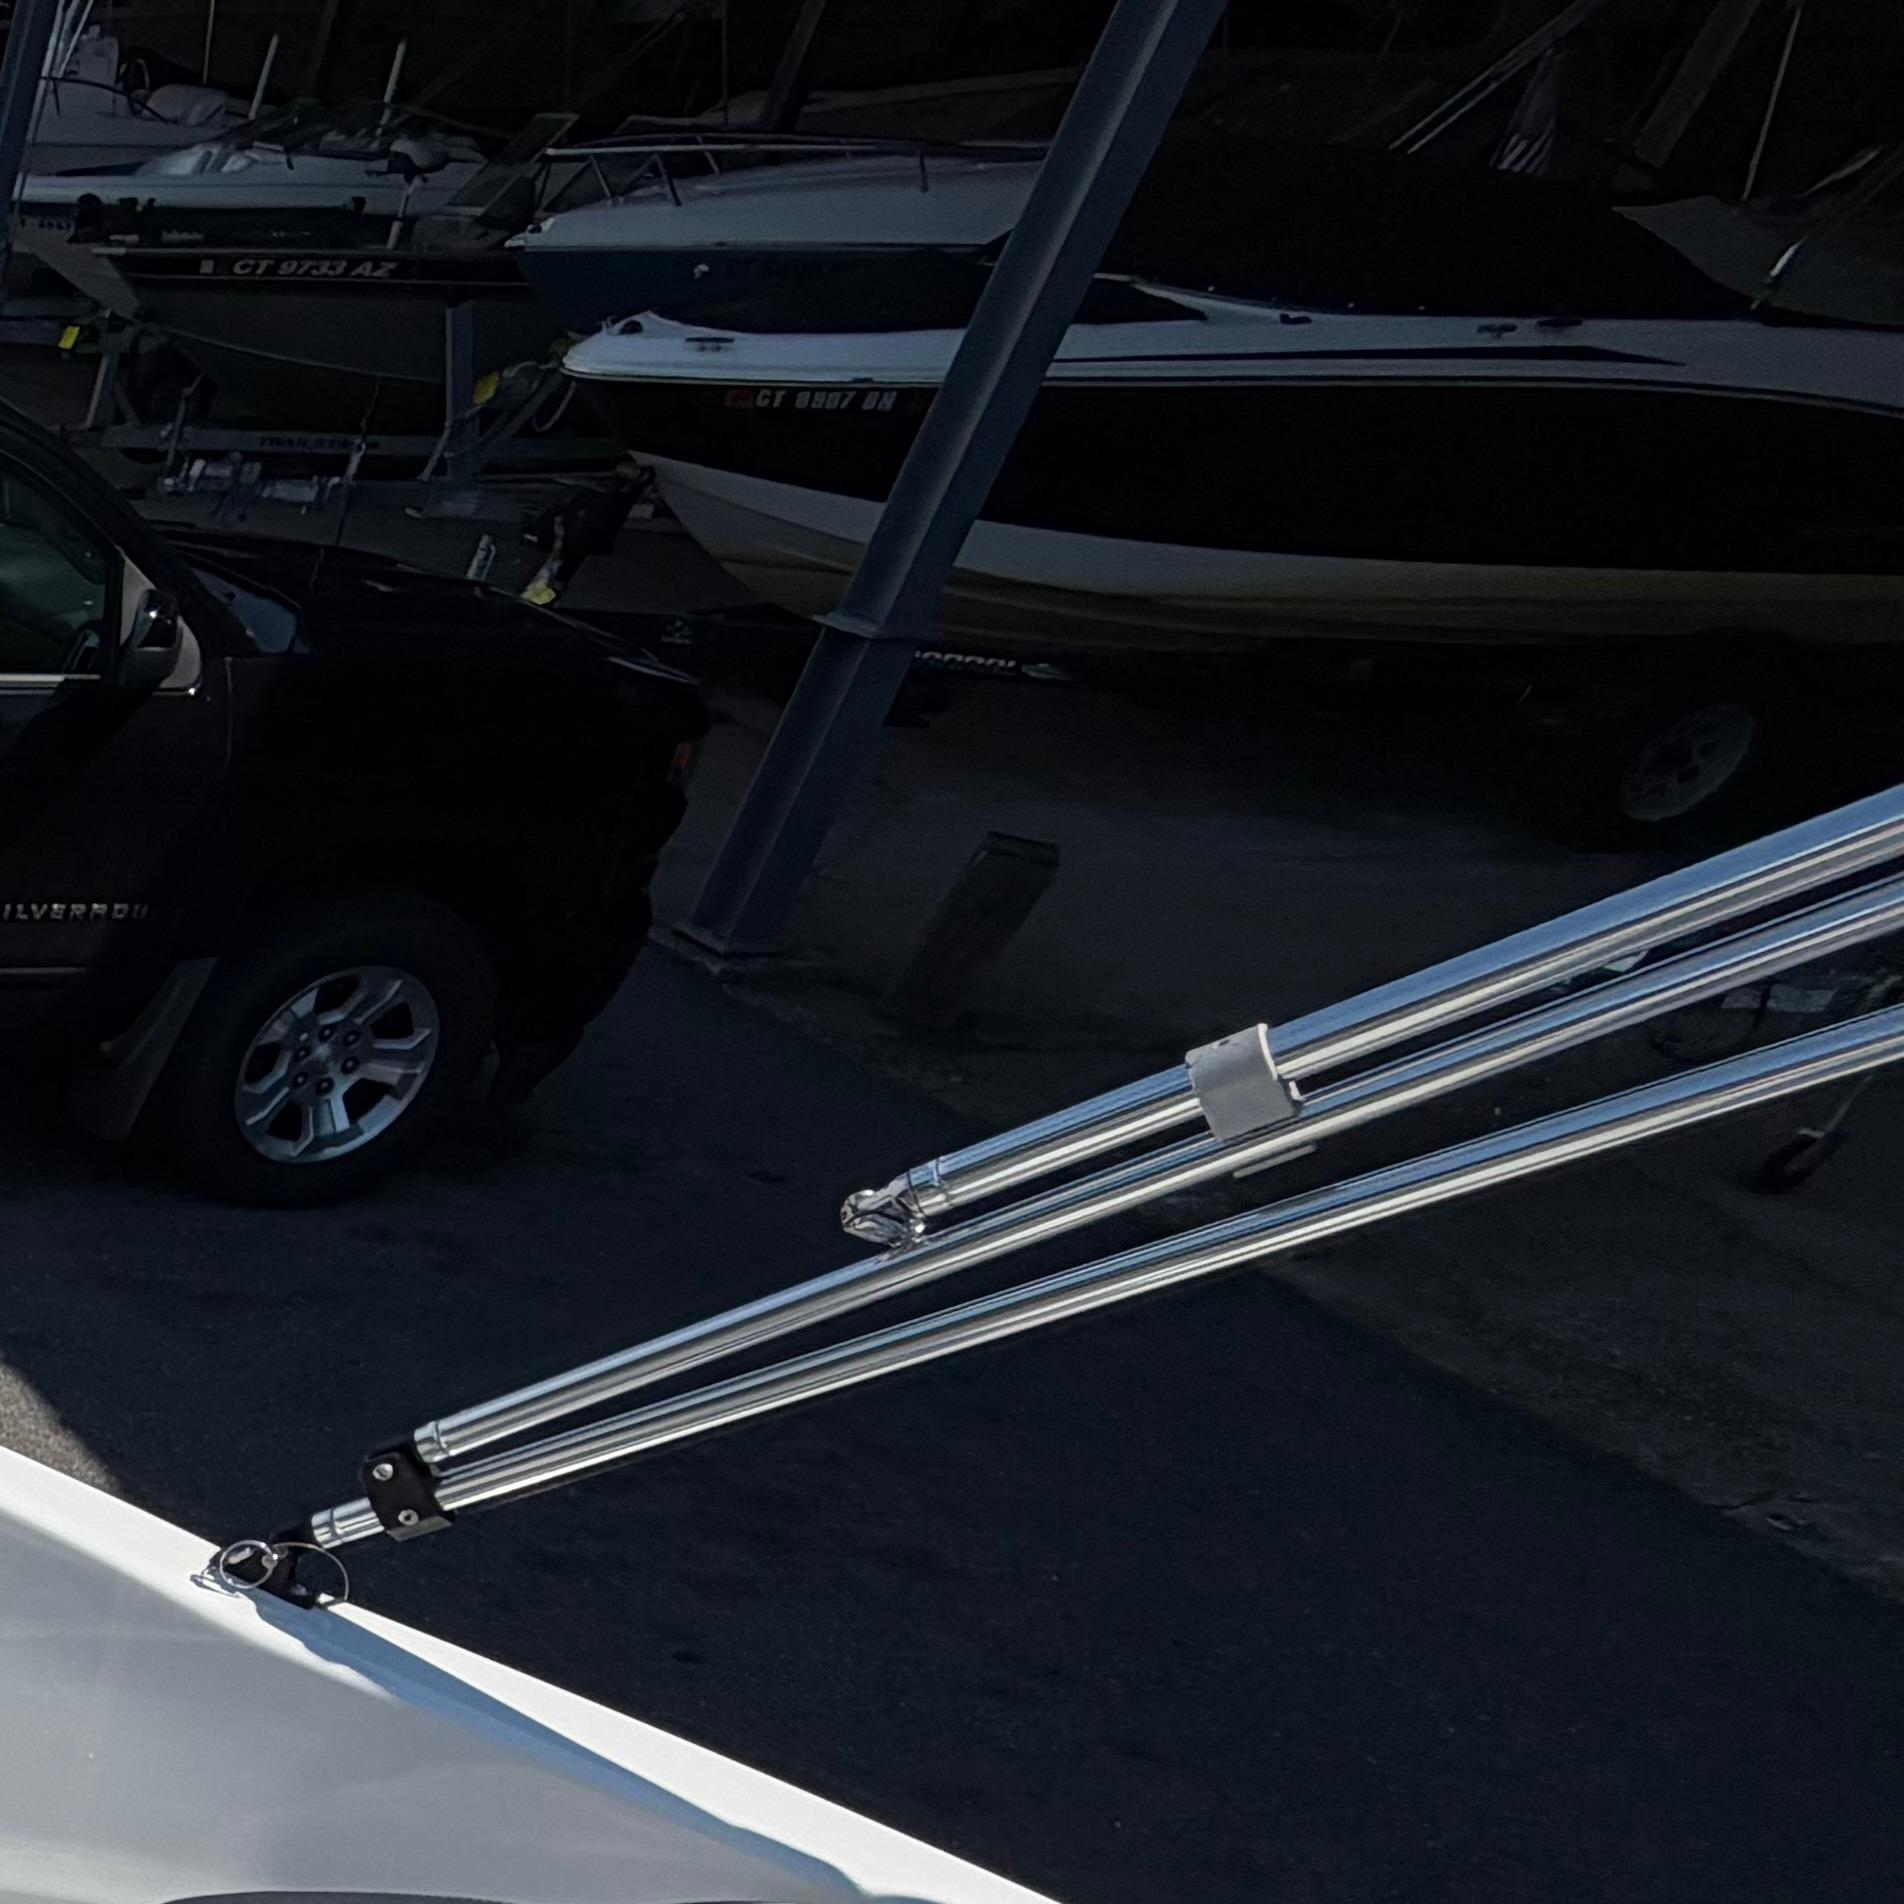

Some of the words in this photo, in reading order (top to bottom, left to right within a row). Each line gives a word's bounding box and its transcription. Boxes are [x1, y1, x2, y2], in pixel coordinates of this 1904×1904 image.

[232, 258, 275, 276] CT
[277, 259, 348, 277] 9733
[350, 260, 399, 278] AZ
[755, 389, 787, 408] CT
